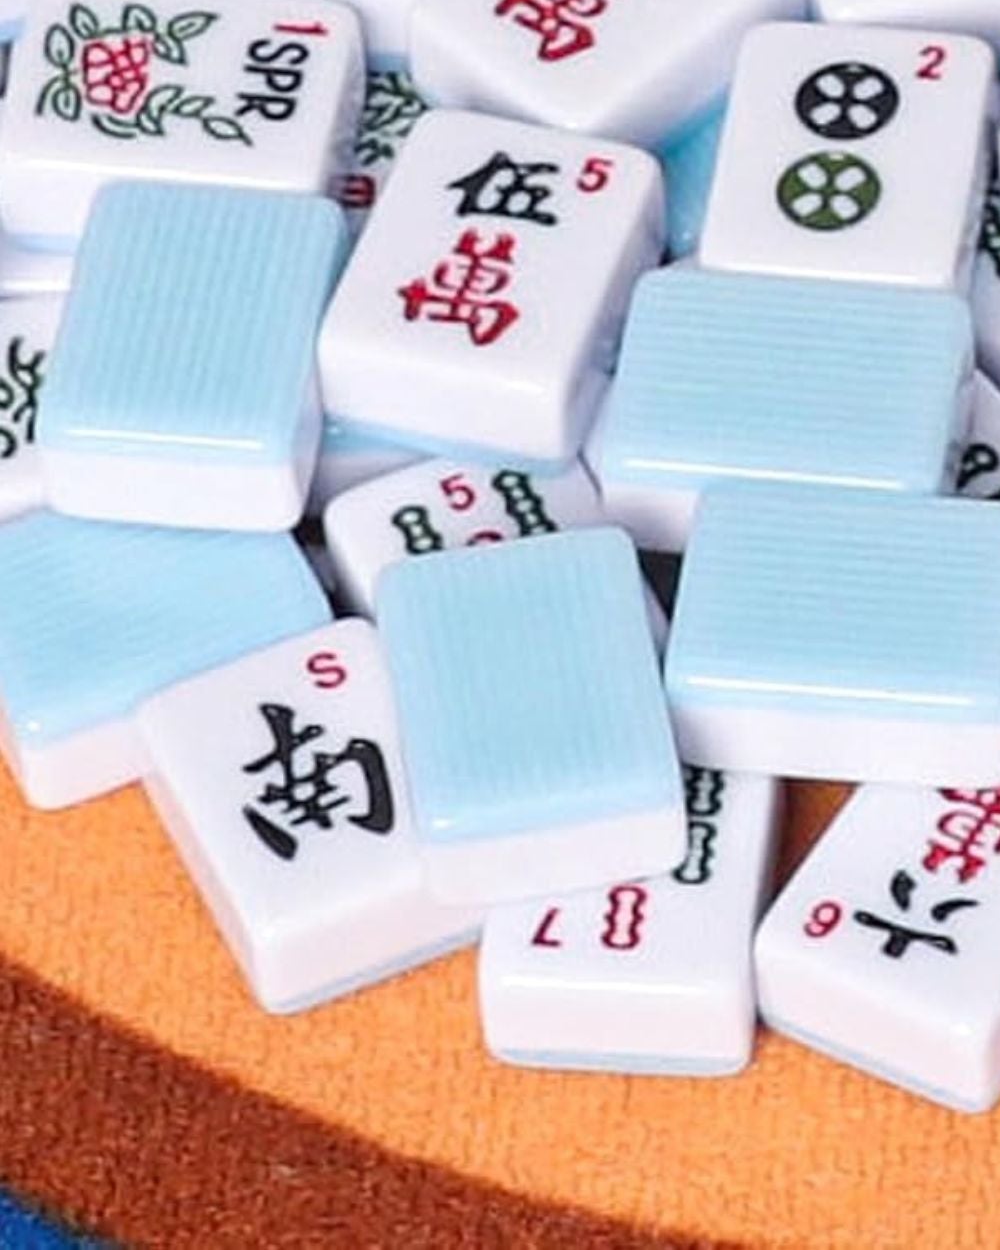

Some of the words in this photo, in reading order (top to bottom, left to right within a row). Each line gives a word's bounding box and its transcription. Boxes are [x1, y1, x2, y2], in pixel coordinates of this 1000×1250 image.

[273, 23, 328, 36] 1
[235, 38, 310, 123] SPR
[916, 46, 946, 80] 2
[576, 158, 613, 193] 5
[440, 474, 476, 512] 5
[306, 652, 347, 689] S
[242, 702, 395, 862] 南
[531, 908, 562, 948] 7
